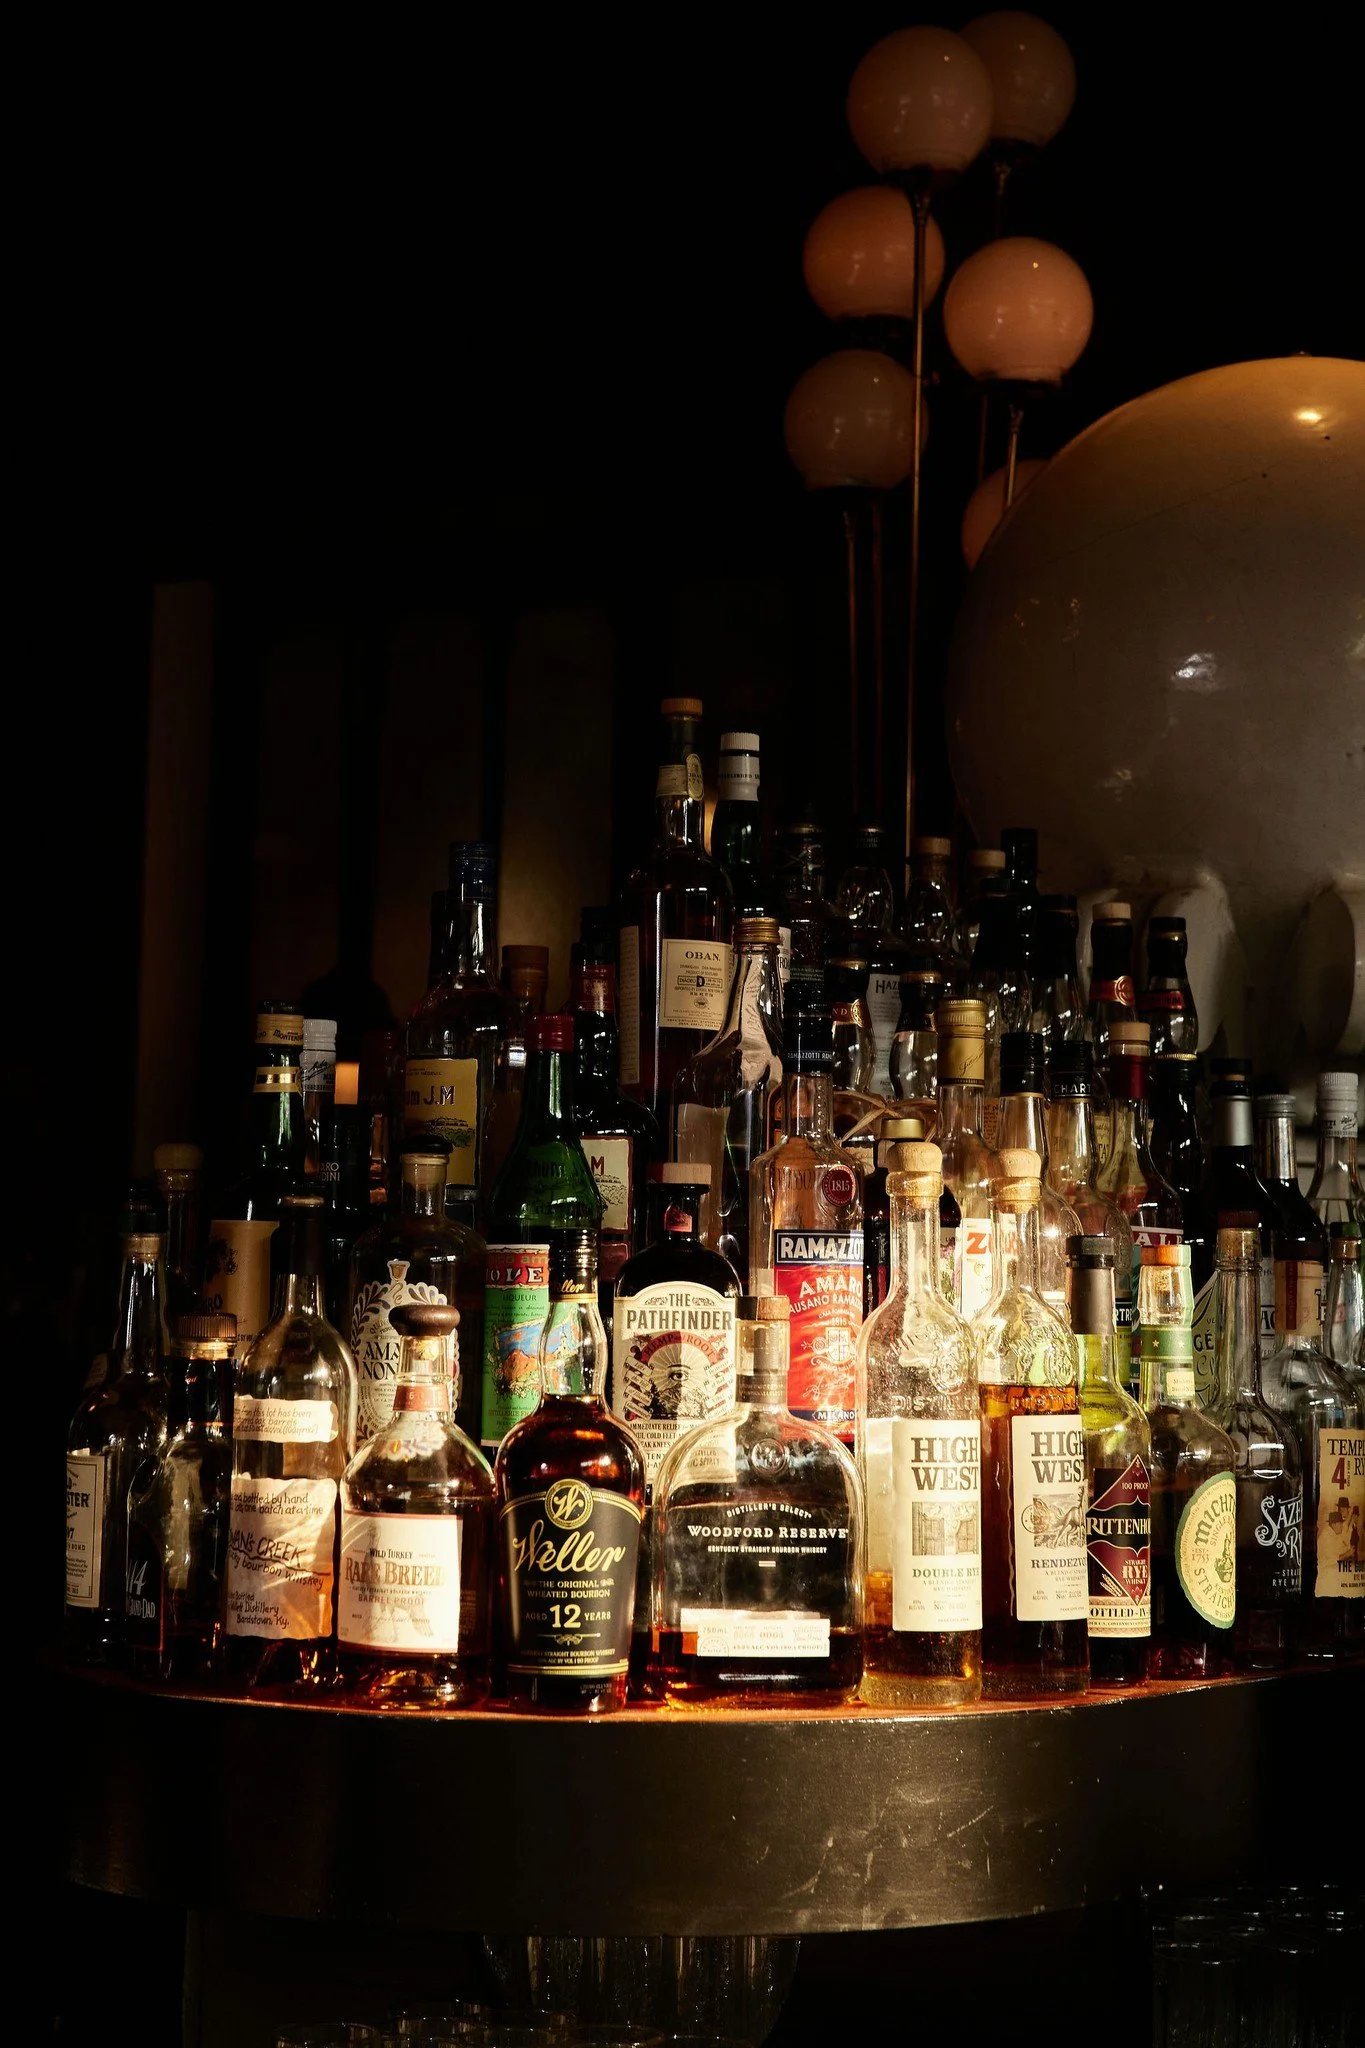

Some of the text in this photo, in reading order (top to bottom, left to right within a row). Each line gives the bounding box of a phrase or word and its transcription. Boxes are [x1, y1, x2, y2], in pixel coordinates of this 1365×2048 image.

[685, 951, 720, 962] OBAN
[423, 1086, 455, 1106] J.M
[590, 1156, 604, 1176] M
[832, 1180, 850, 1192] 1815
[799, 1274, 862, 1298] AMARO
[502, 1294, 536, 1302] LIQUEUR
[669, 1293, 690, 1307] THE
[626, 1310, 732, 1330] PATHFINDER
[832, 1318, 846, 1326] 1815
[643, 1334, 714, 1357] HEMP ROOT
[817, 1410, 855, 1420] MILANO
[910, 1436, 978, 1464] HIGH
[910, 1466, 979, 1491] WEST
[1032, 1460, 1086, 1484] WES
[1332, 1456, 1346, 1490] 4
[1122, 1482, 1132, 1490] 100
[244, 1492, 269, 1504] bottled
[272, 1493, 282, 1506] by
[284, 1492, 308, 1504] hand
[259, 1504, 284, 1515] batch
[726, 1502, 809, 1518] DISTILLER'S SELECT
[687, 1525, 846, 1539] WOODFORD RESERVE
[256, 1536, 307, 1568] CREEK
[512, 1519, 626, 1573] Weller
[740, 1546, 770, 1554] STRAIGHT
[772, 1546, 800, 1554] BOURBON
[801, 1546, 828, 1554] WHISKEY
[369, 1548, 414, 1559] WILD TURKEY
[1192, 1553, 1209, 1564] 1753
[345, 1557, 448, 1587] RARE BREED
[912, 1568, 964, 1578] DOUBLE
[1122, 1565, 1148, 1578] RYE
[1337, 1560, 1352, 1572] THE
[242, 1560, 282, 1576] bourbon
[285, 1570, 324, 1591] whiskey
[1272, 1578, 1287, 1586] RYE
[537, 1580, 599, 1588] THE ORIGINAL
[358, 1594, 426, 1606] BARREL PROOF
[526, 1589, 610, 1598] WHEATED BOURBON
[244, 1600, 279, 1617] Distillery
[276, 1616, 290, 1630] Ky.
[525, 1611, 611, 1621] AGED YEARS
[548, 1604, 582, 1629] 12
